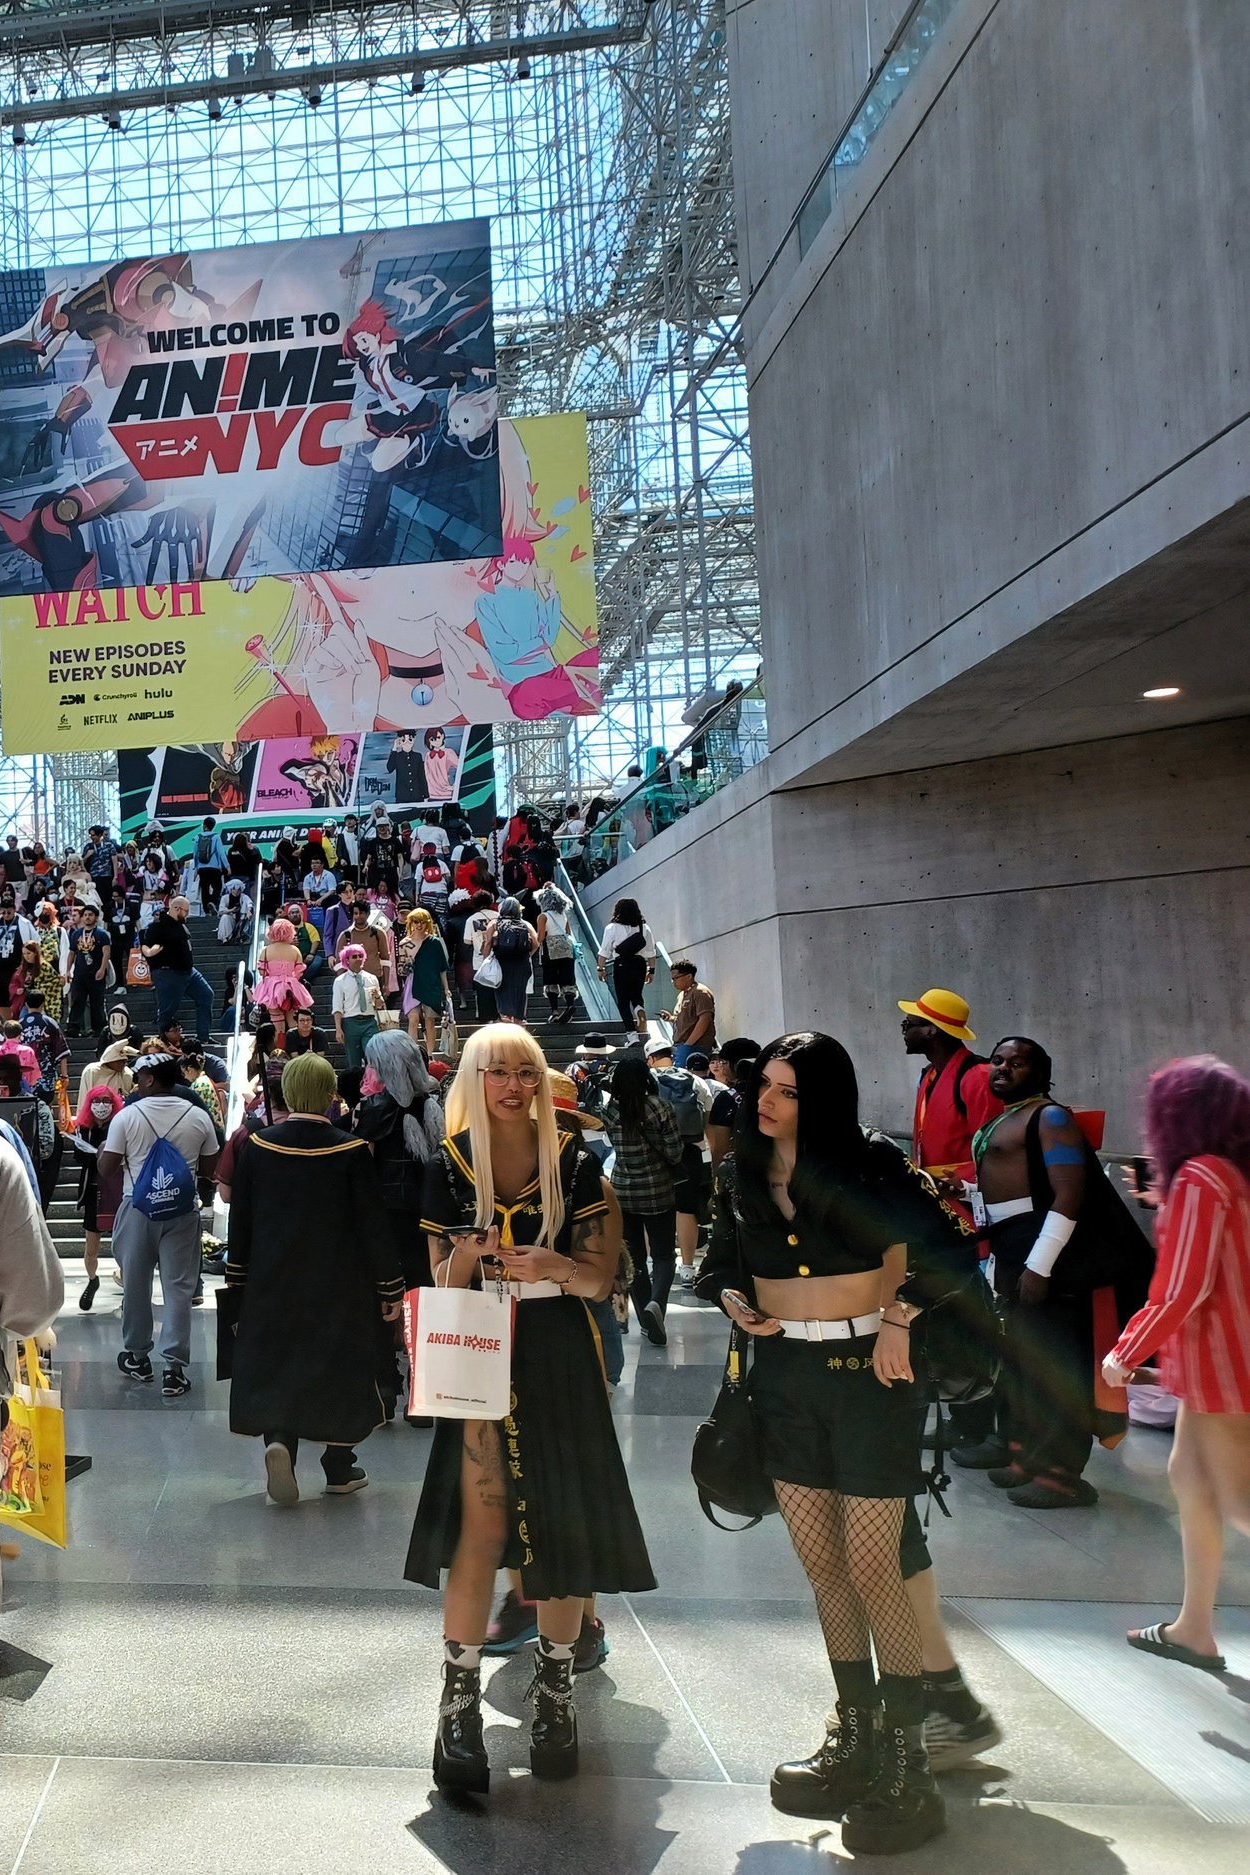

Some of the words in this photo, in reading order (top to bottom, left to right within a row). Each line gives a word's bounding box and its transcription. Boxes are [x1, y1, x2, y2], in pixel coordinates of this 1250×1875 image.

[147, 317, 294, 353] WELCOME
[301, 312, 340, 336] TO
[202, 403, 352, 475] NYC
[136, 435, 199, 461] アニメ
[49, 648, 90, 664] NEW
[95, 640, 186, 661] EPISODES
[48, 665, 106, 683] EVERY
[111, 659, 186, 678] SUNDAY
[144, 688, 173, 699] hulu
[83, 714, 118, 726] NETFLIX
[127, 710, 174, 721] ANIPLUS
[257, 788, 293, 798] BLEACH
[145, 1187, 181, 1201] ASCEND
[426, 1332, 461, 1346] AKIBA
